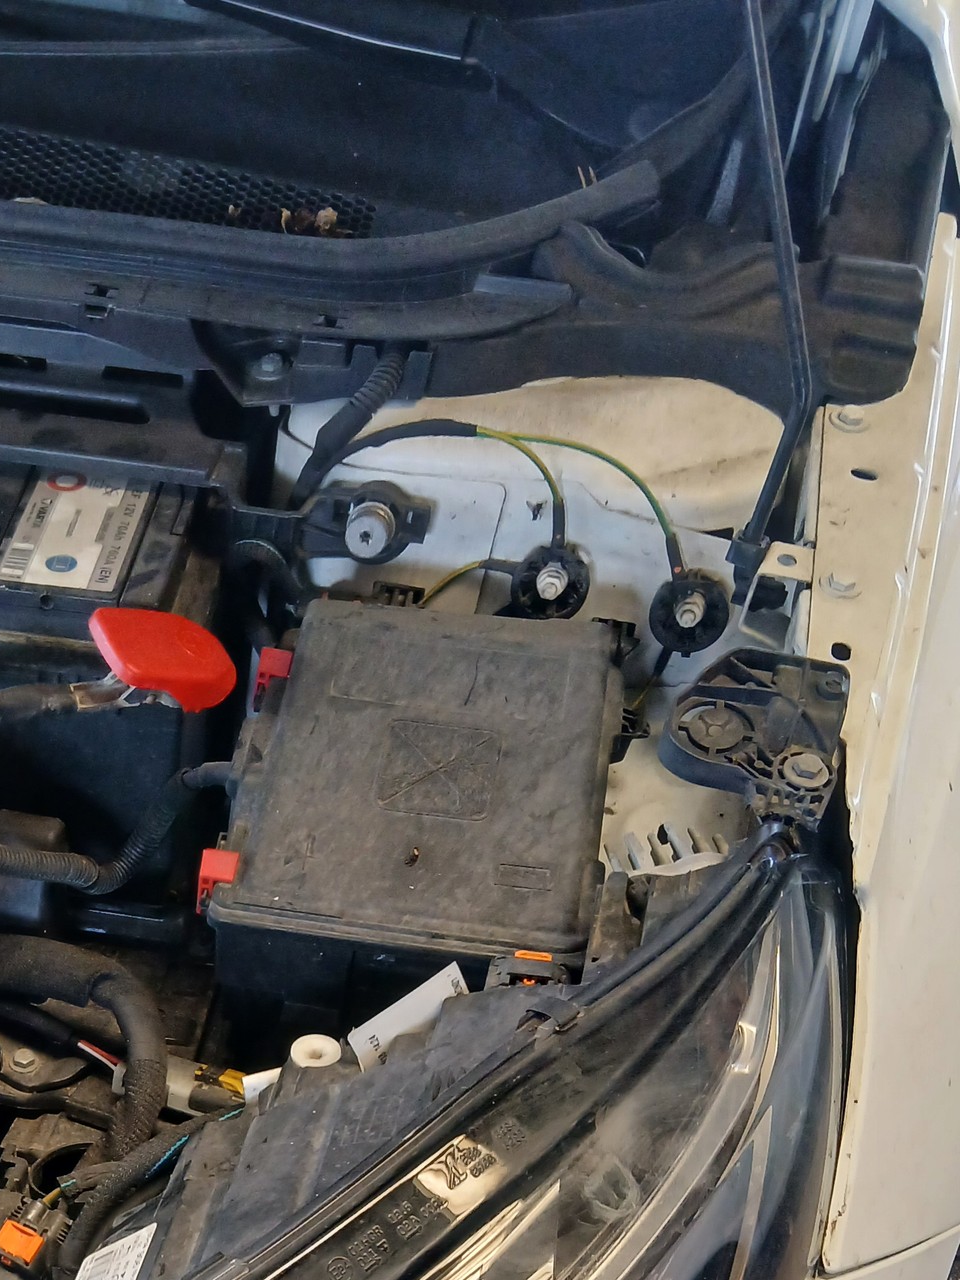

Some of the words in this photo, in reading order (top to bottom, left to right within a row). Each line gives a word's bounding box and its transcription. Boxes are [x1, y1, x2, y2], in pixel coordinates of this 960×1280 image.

[32, 506, 49, 527] VARTA
[123, 503, 136, 518] 12V
[114, 521, 130, 541] 70Ah
[95, 567, 112, 584] (EN)
